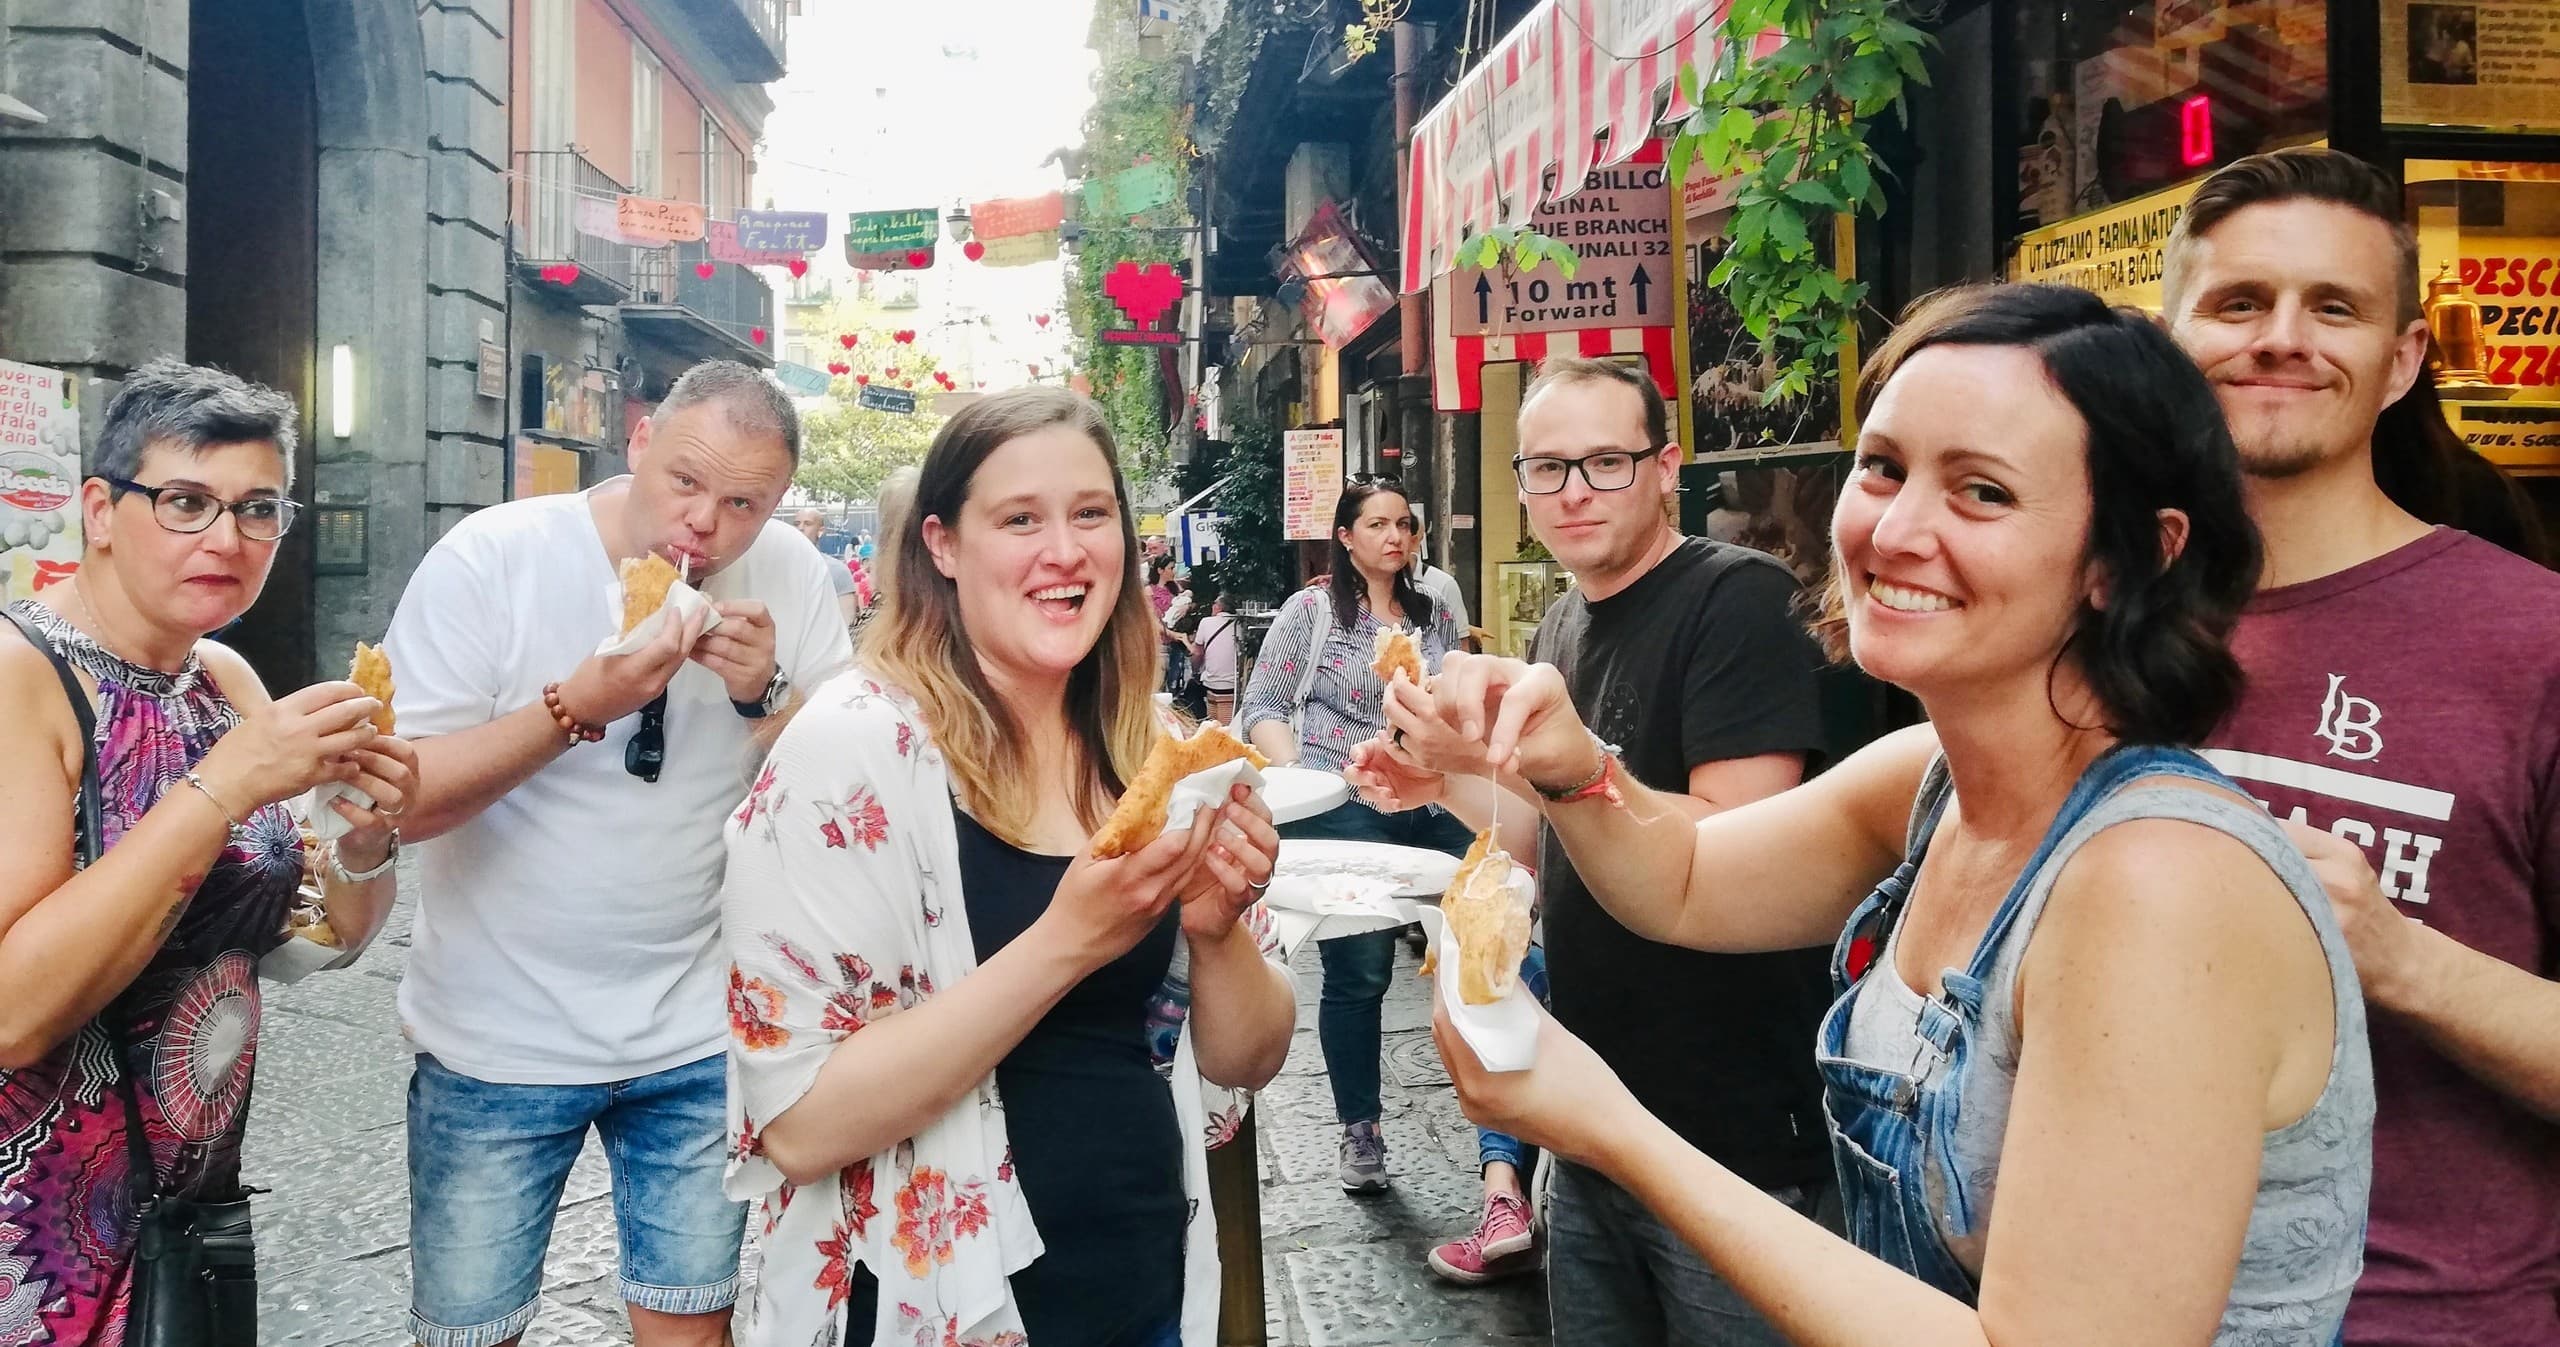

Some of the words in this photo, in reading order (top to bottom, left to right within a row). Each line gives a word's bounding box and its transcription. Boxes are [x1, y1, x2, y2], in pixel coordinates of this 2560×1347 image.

[1543, 170, 1663, 192] OBILLO
[1575, 218, 1668, 235] BRANCH
[2099, 216, 2139, 257] FARINA
[2142, 204, 2184, 244] NATUR
[1644, 241, 1671, 256] 32
[2128, 249, 2164, 286] BIOLO
[2460, 258, 2560, 297] PESC
[1505, 279, 1550, 304] 10
[1567, 276, 1617, 301] mt
[1505, 299, 1617, 323] Forward
[2481, 305, 2560, 336] PECI
[0, 384, 30, 400] era
[0, 400, 47, 417] rella
[0, 412, 36, 431] fala
[0, 430, 37, 446] ana
